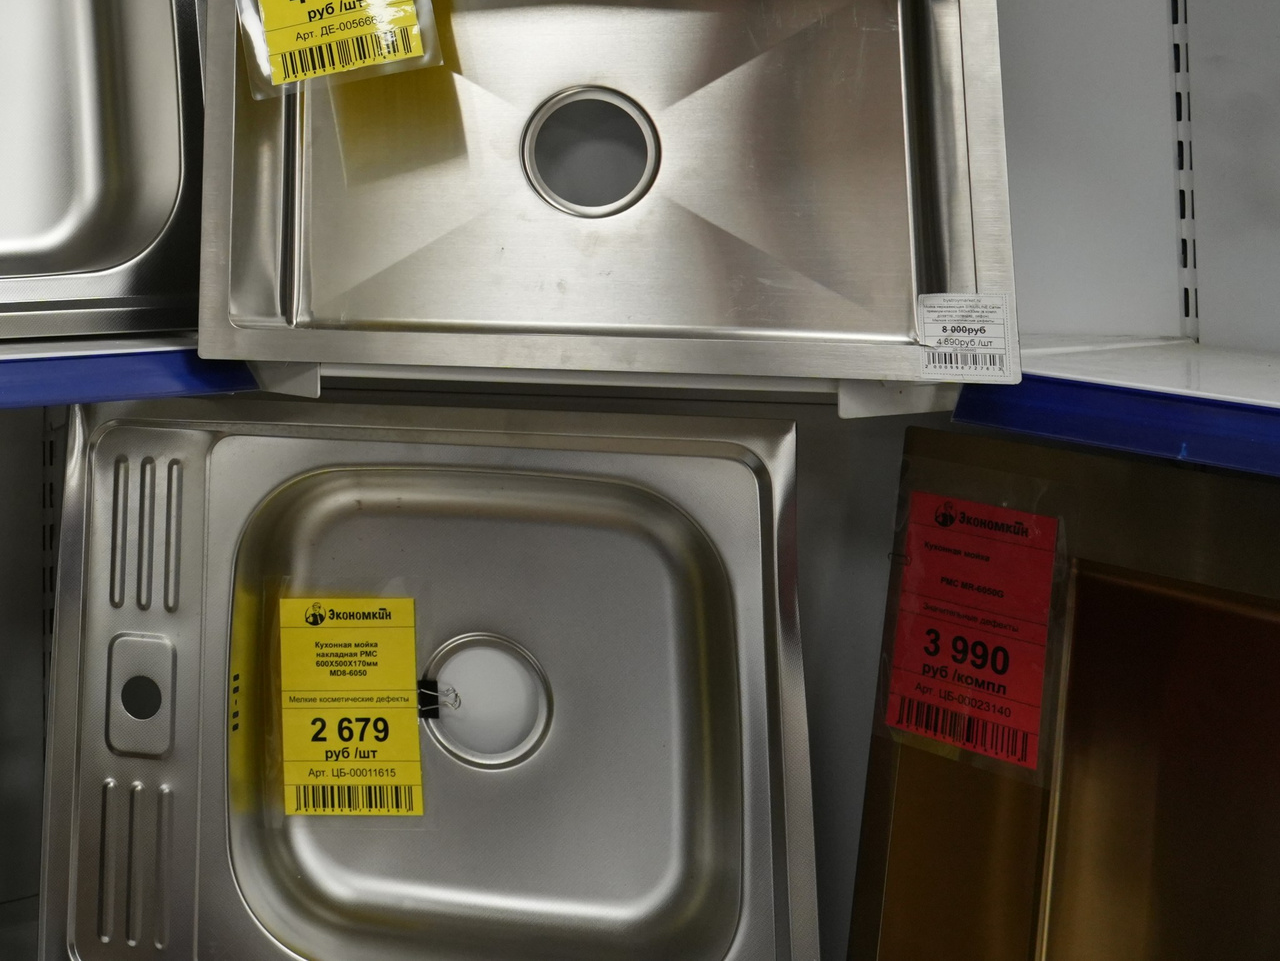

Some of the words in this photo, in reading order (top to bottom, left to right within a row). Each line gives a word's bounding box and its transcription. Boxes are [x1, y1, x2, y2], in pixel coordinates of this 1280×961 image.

[307, 1, 334, 22] руб
[295, 30, 317, 41] Арт.
[923, 628, 940, 656] 3
[951, 635, 1009, 675] 990
[921, 663, 948, 679] руб
[951, 668, 1006, 695] /компл
[310, 717, 327, 742] 2
[337, 716, 389, 742] 679
[324, 746, 350, 761] руб
[354, 746, 377, 759] /шт
[307, 767, 328, 778] Арт.
[331, 767, 396, 778] ЦБ-00011615
